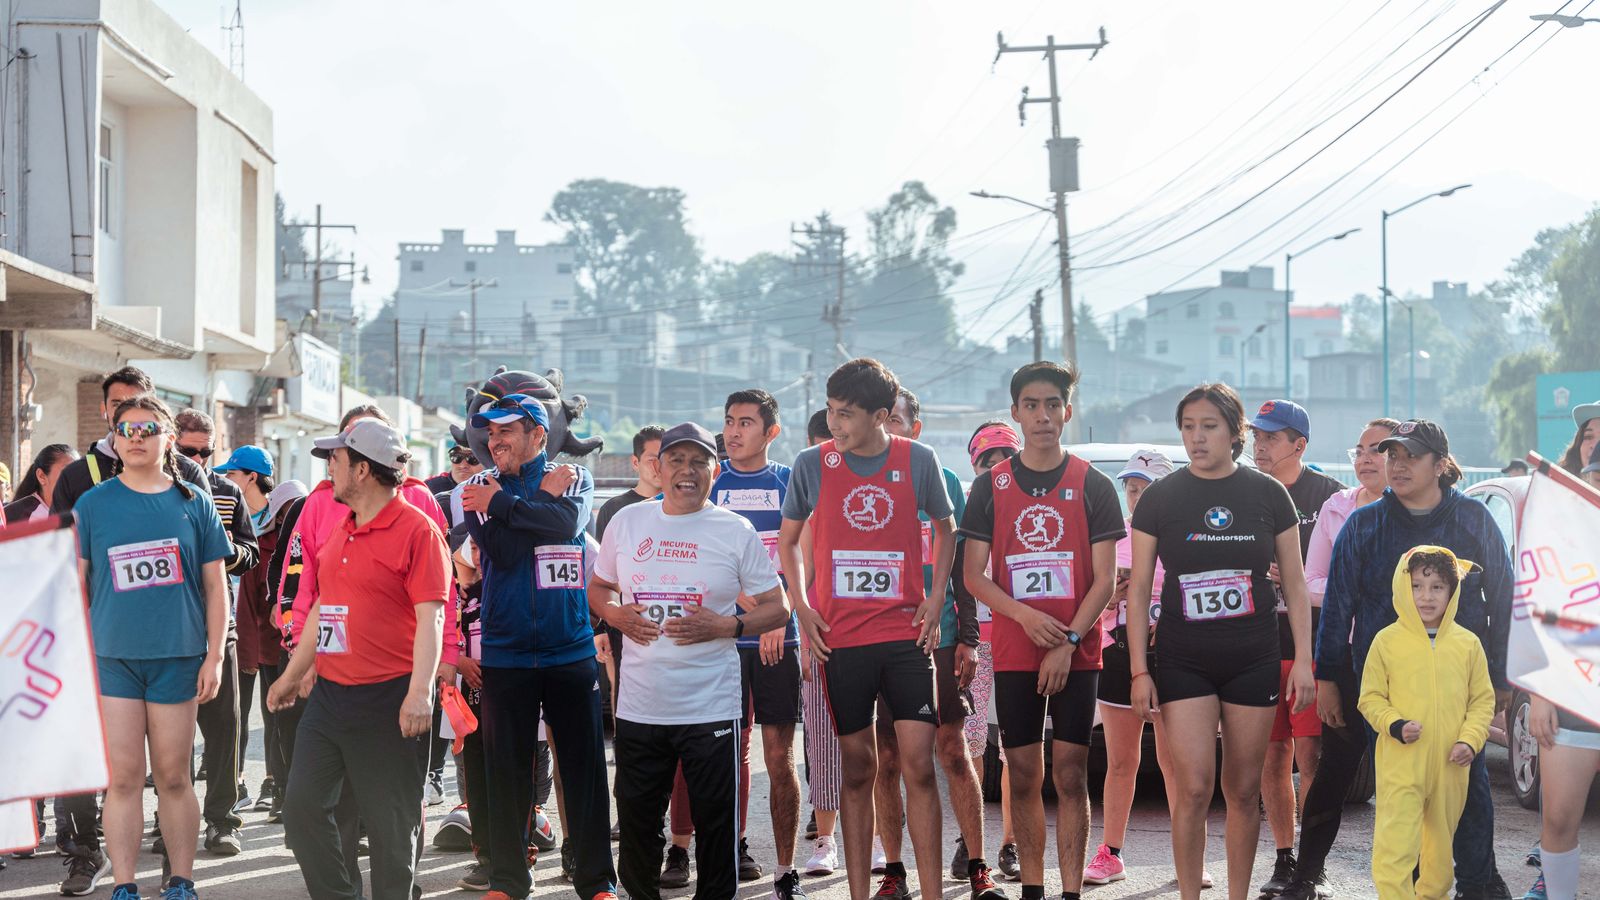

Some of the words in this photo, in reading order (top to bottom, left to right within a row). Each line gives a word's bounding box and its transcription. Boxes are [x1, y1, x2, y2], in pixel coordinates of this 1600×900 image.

[659, 540, 699, 550] IMCUFIDE
[1207, 534, 1256, 542] Motorsport
[657, 548, 697, 559] LERMA
[122, 558, 171, 583] 108
[546, 563, 579, 583] 145
[843, 570, 891, 593] 129
[1025, 571, 1053, 593] 21
[1192, 588, 1242, 614] 130
[648, 604, 683, 625] 95
[713, 727, 732, 738] Wilson
